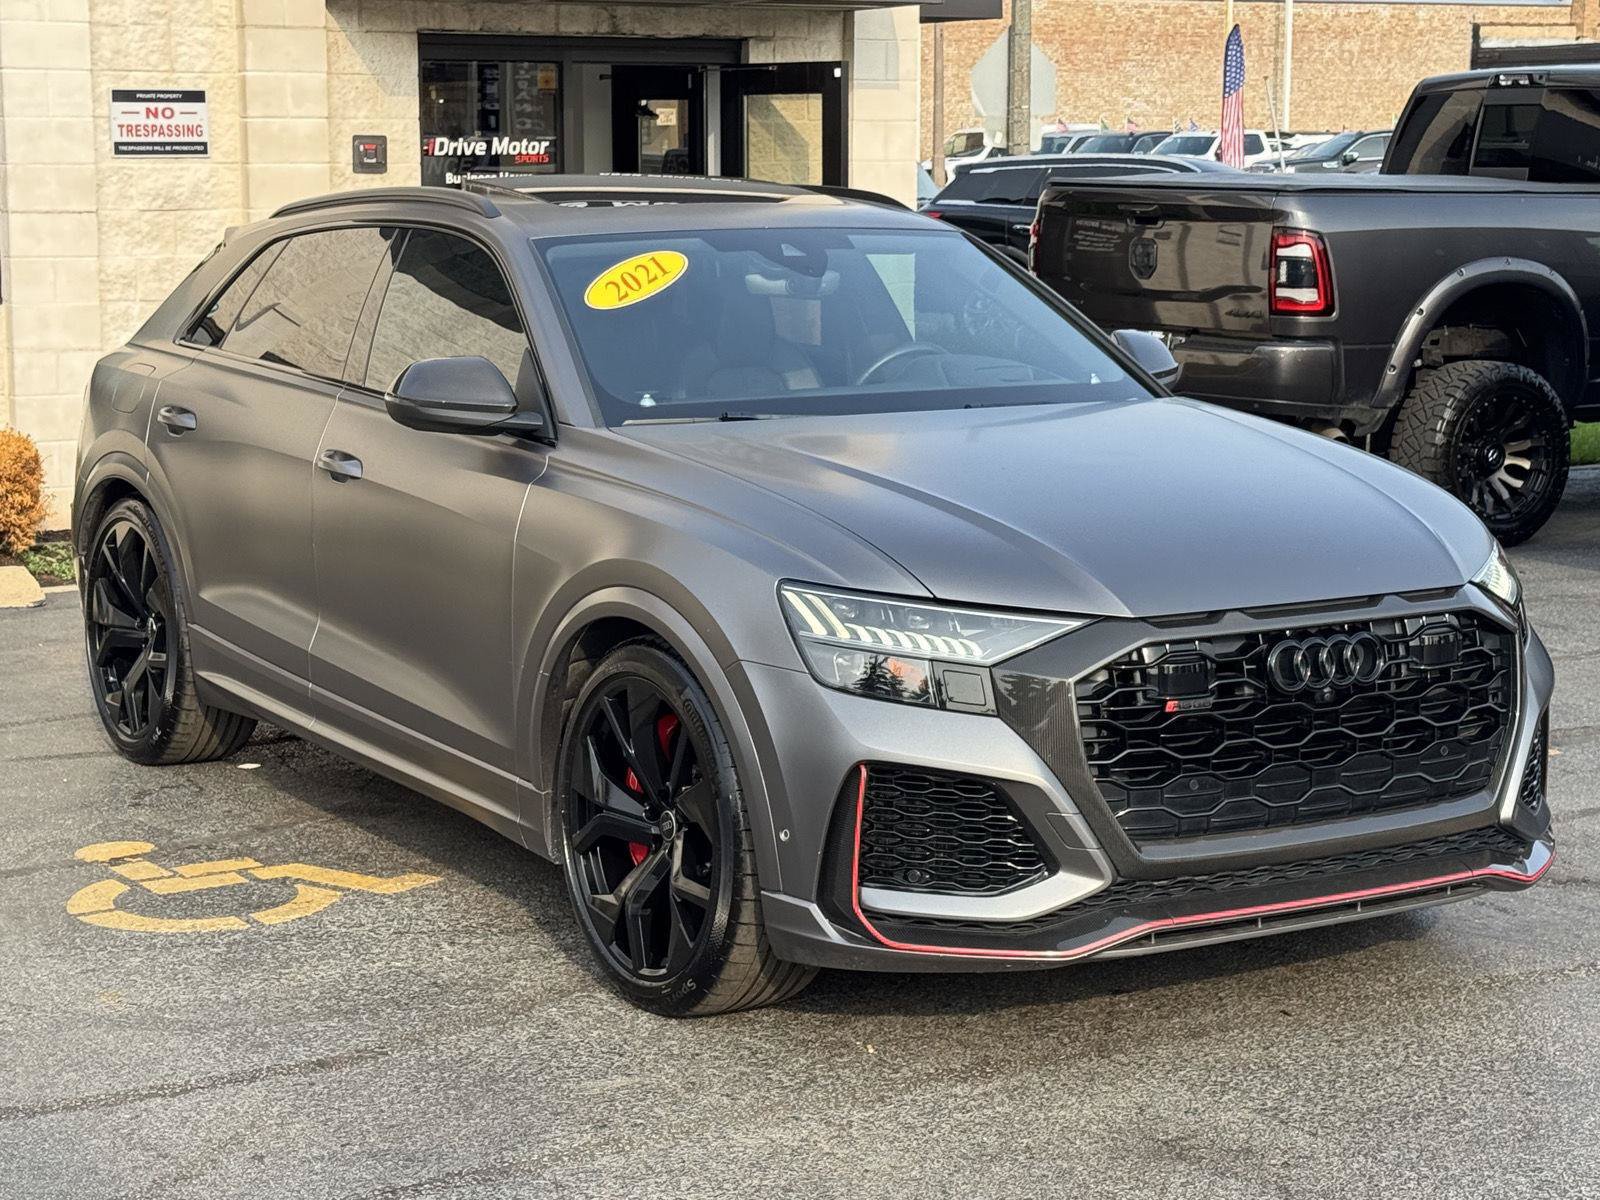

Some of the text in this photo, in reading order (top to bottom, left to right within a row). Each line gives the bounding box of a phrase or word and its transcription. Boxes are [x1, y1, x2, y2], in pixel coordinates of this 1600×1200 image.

[145, 106, 175, 119] NO
[117, 124, 204, 138] TRESPASSING
[491, 137, 550, 156] Motor
[514, 154, 550, 164] SPORTS
[604, 256, 671, 302] 2021
